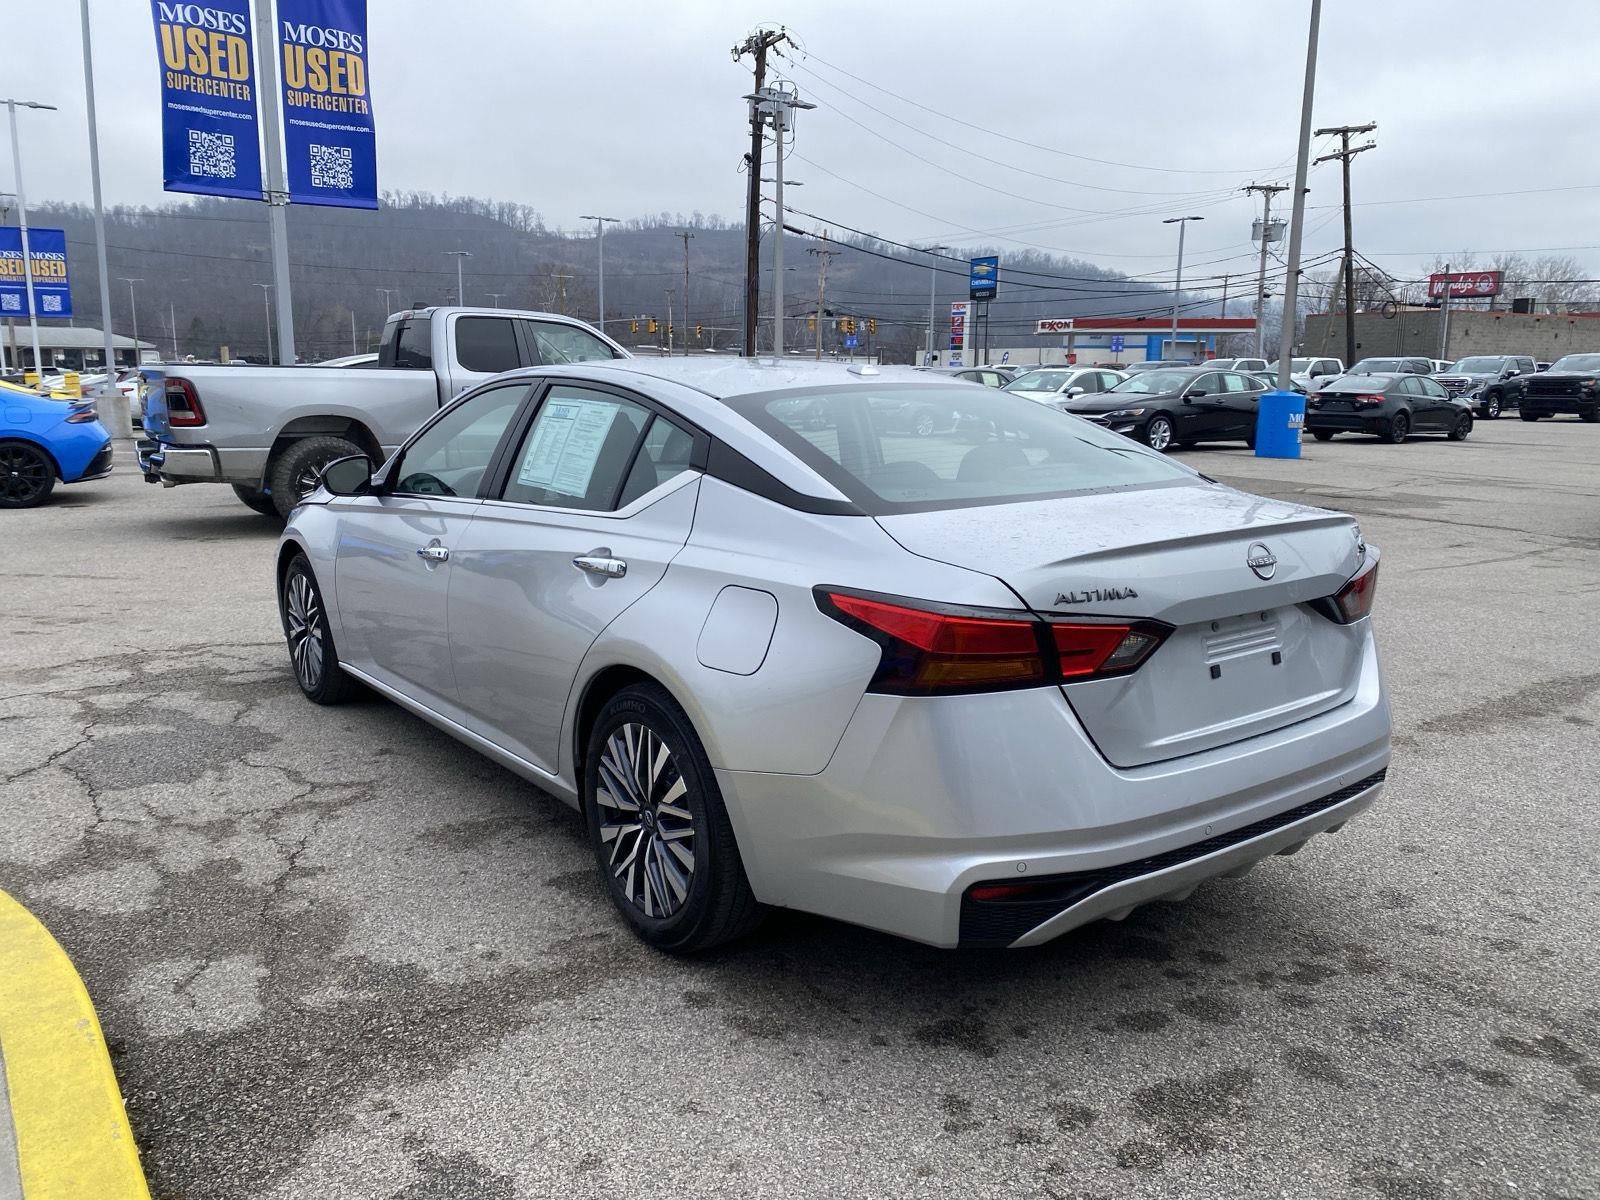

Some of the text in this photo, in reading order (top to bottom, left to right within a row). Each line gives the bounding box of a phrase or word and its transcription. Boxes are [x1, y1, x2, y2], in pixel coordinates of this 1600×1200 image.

[157, 1, 246, 35] MOSES
[283, 20, 363, 54] MOSES
[160, 23, 249, 81] USED
[284, 43, 366, 97] USED
[166, 71, 251, 101] SUPERCENTER
[167, 102, 253, 120] mosesusedsupercenter.com
[287, 90, 368, 115] SUPERCENTER
[289, 118, 370, 133] mosesusedsupercenter.com
[0, 250, 24, 258] OSES
[30, 251, 65, 260] MOSES
[0, 259, 25, 275] SED
[31, 259, 66, 277] USED
[1433, 275, 1474, 294] Wndy's
[1040, 320, 1071, 332] EXXON
[1053, 586, 1139, 606] ALTIMA
